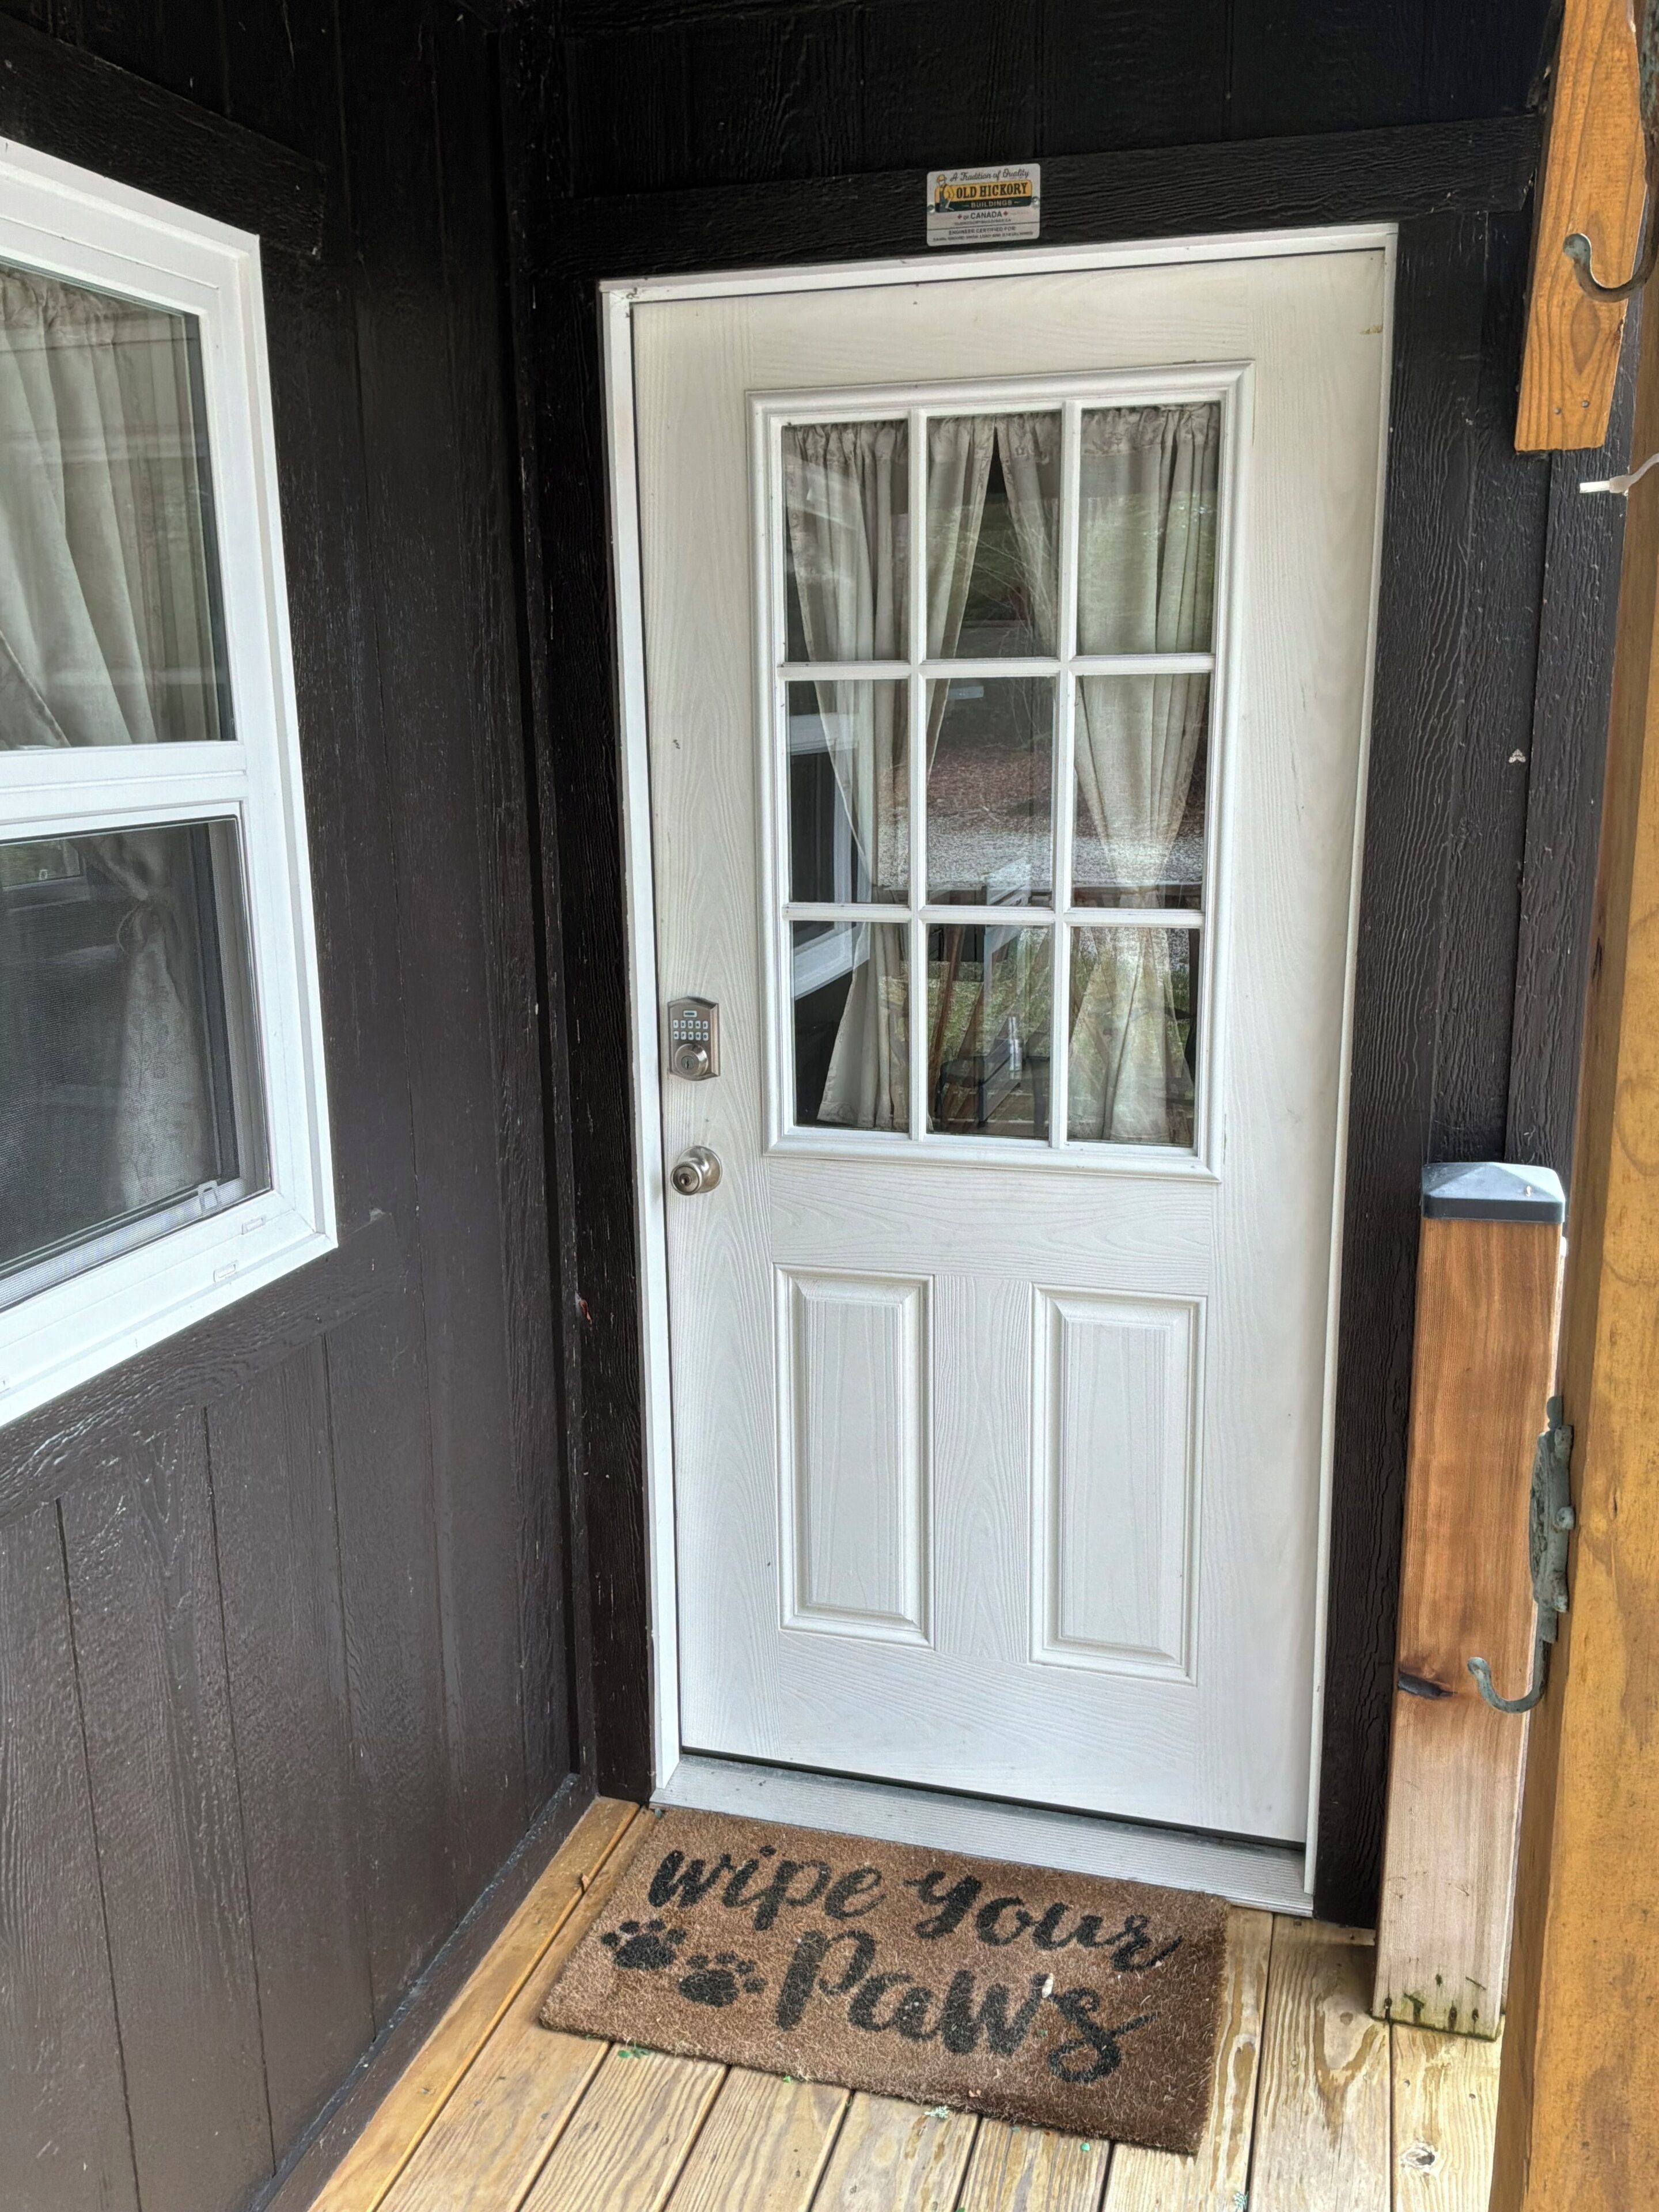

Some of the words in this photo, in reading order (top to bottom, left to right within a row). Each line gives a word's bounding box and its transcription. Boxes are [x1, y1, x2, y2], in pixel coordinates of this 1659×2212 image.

[950, 173, 958, 181] A
[960, 171, 991, 181] Tradition
[993, 171, 1001, 180] of
[1003, 168, 1029, 179] Quality
[956, 185, 977, 199] OLD
[979, 182, 1028, 198] HICKORY
[971, 199, 1013, 209] BUILDINGS
[970, 211, 1002, 219] CANADA
[647, 1845, 887, 1931] wipe
[904, 1868, 1184, 1972] your
